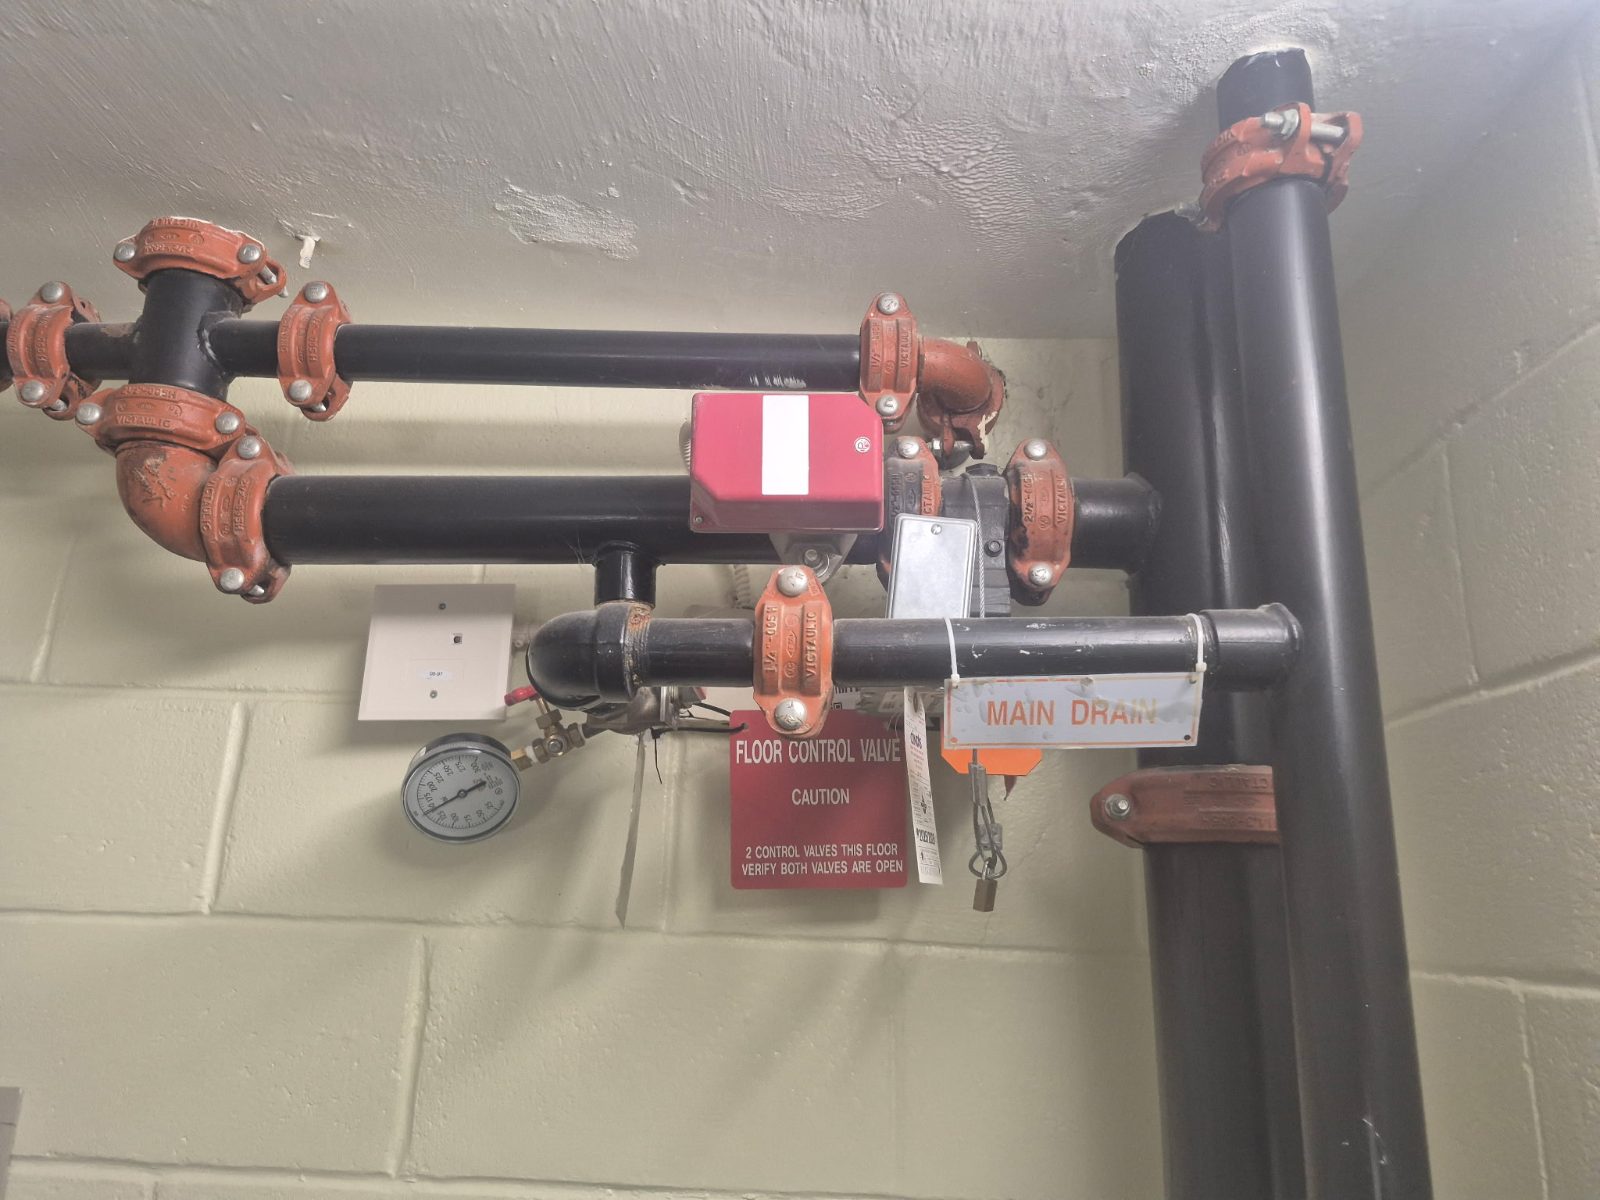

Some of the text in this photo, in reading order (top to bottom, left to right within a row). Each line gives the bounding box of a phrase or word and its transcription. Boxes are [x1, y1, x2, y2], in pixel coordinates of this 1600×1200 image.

[804, 611, 818, 680] VICTAULIC
[986, 697, 1158, 726] MAIN DRAIN
[736, 739, 783, 764] FLOOR
[788, 739, 855, 763] CONTROL
[860, 738, 901, 762] VALVE
[791, 788, 850, 805] CAUTION
[745, 843, 898, 858] 2 CONTROL VALVES THIS FLOOR
[742, 860, 903, 876] VERIFY BOTH VALVES ARE OPEN
